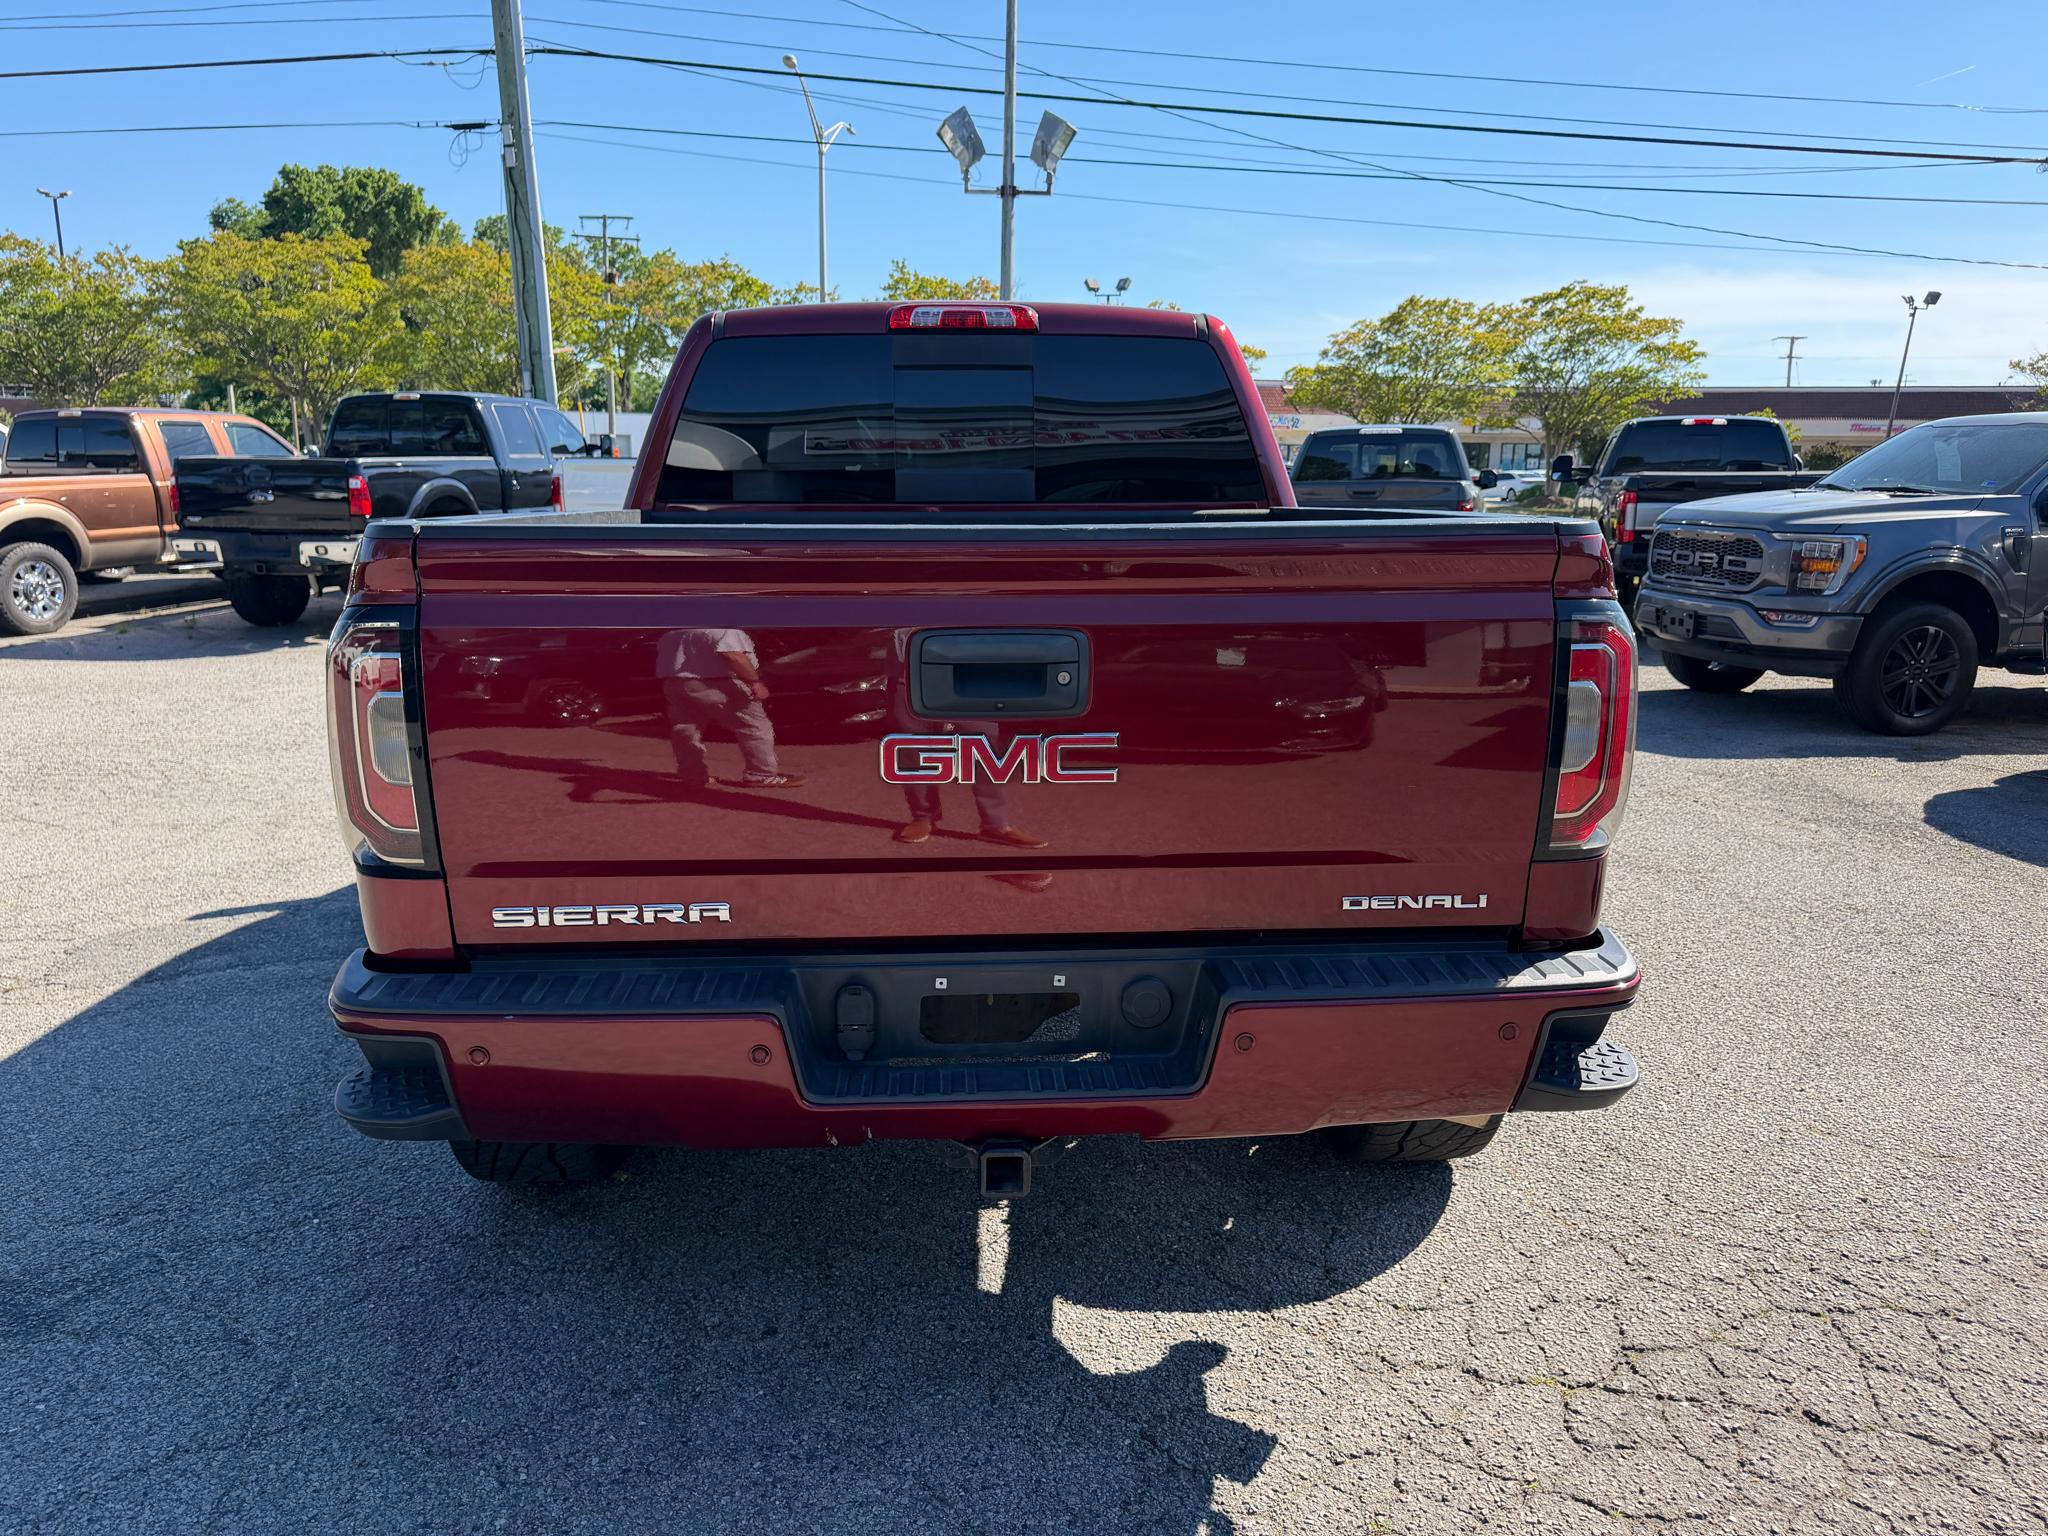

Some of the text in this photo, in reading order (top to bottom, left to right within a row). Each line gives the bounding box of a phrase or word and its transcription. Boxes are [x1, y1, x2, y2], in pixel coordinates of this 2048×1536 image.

[1652, 549, 1762, 572] FORD
[880, 733, 1119, 784] GMC
[1342, 894, 1488, 910] DENALI
[492, 902, 732, 928] SIERRA
